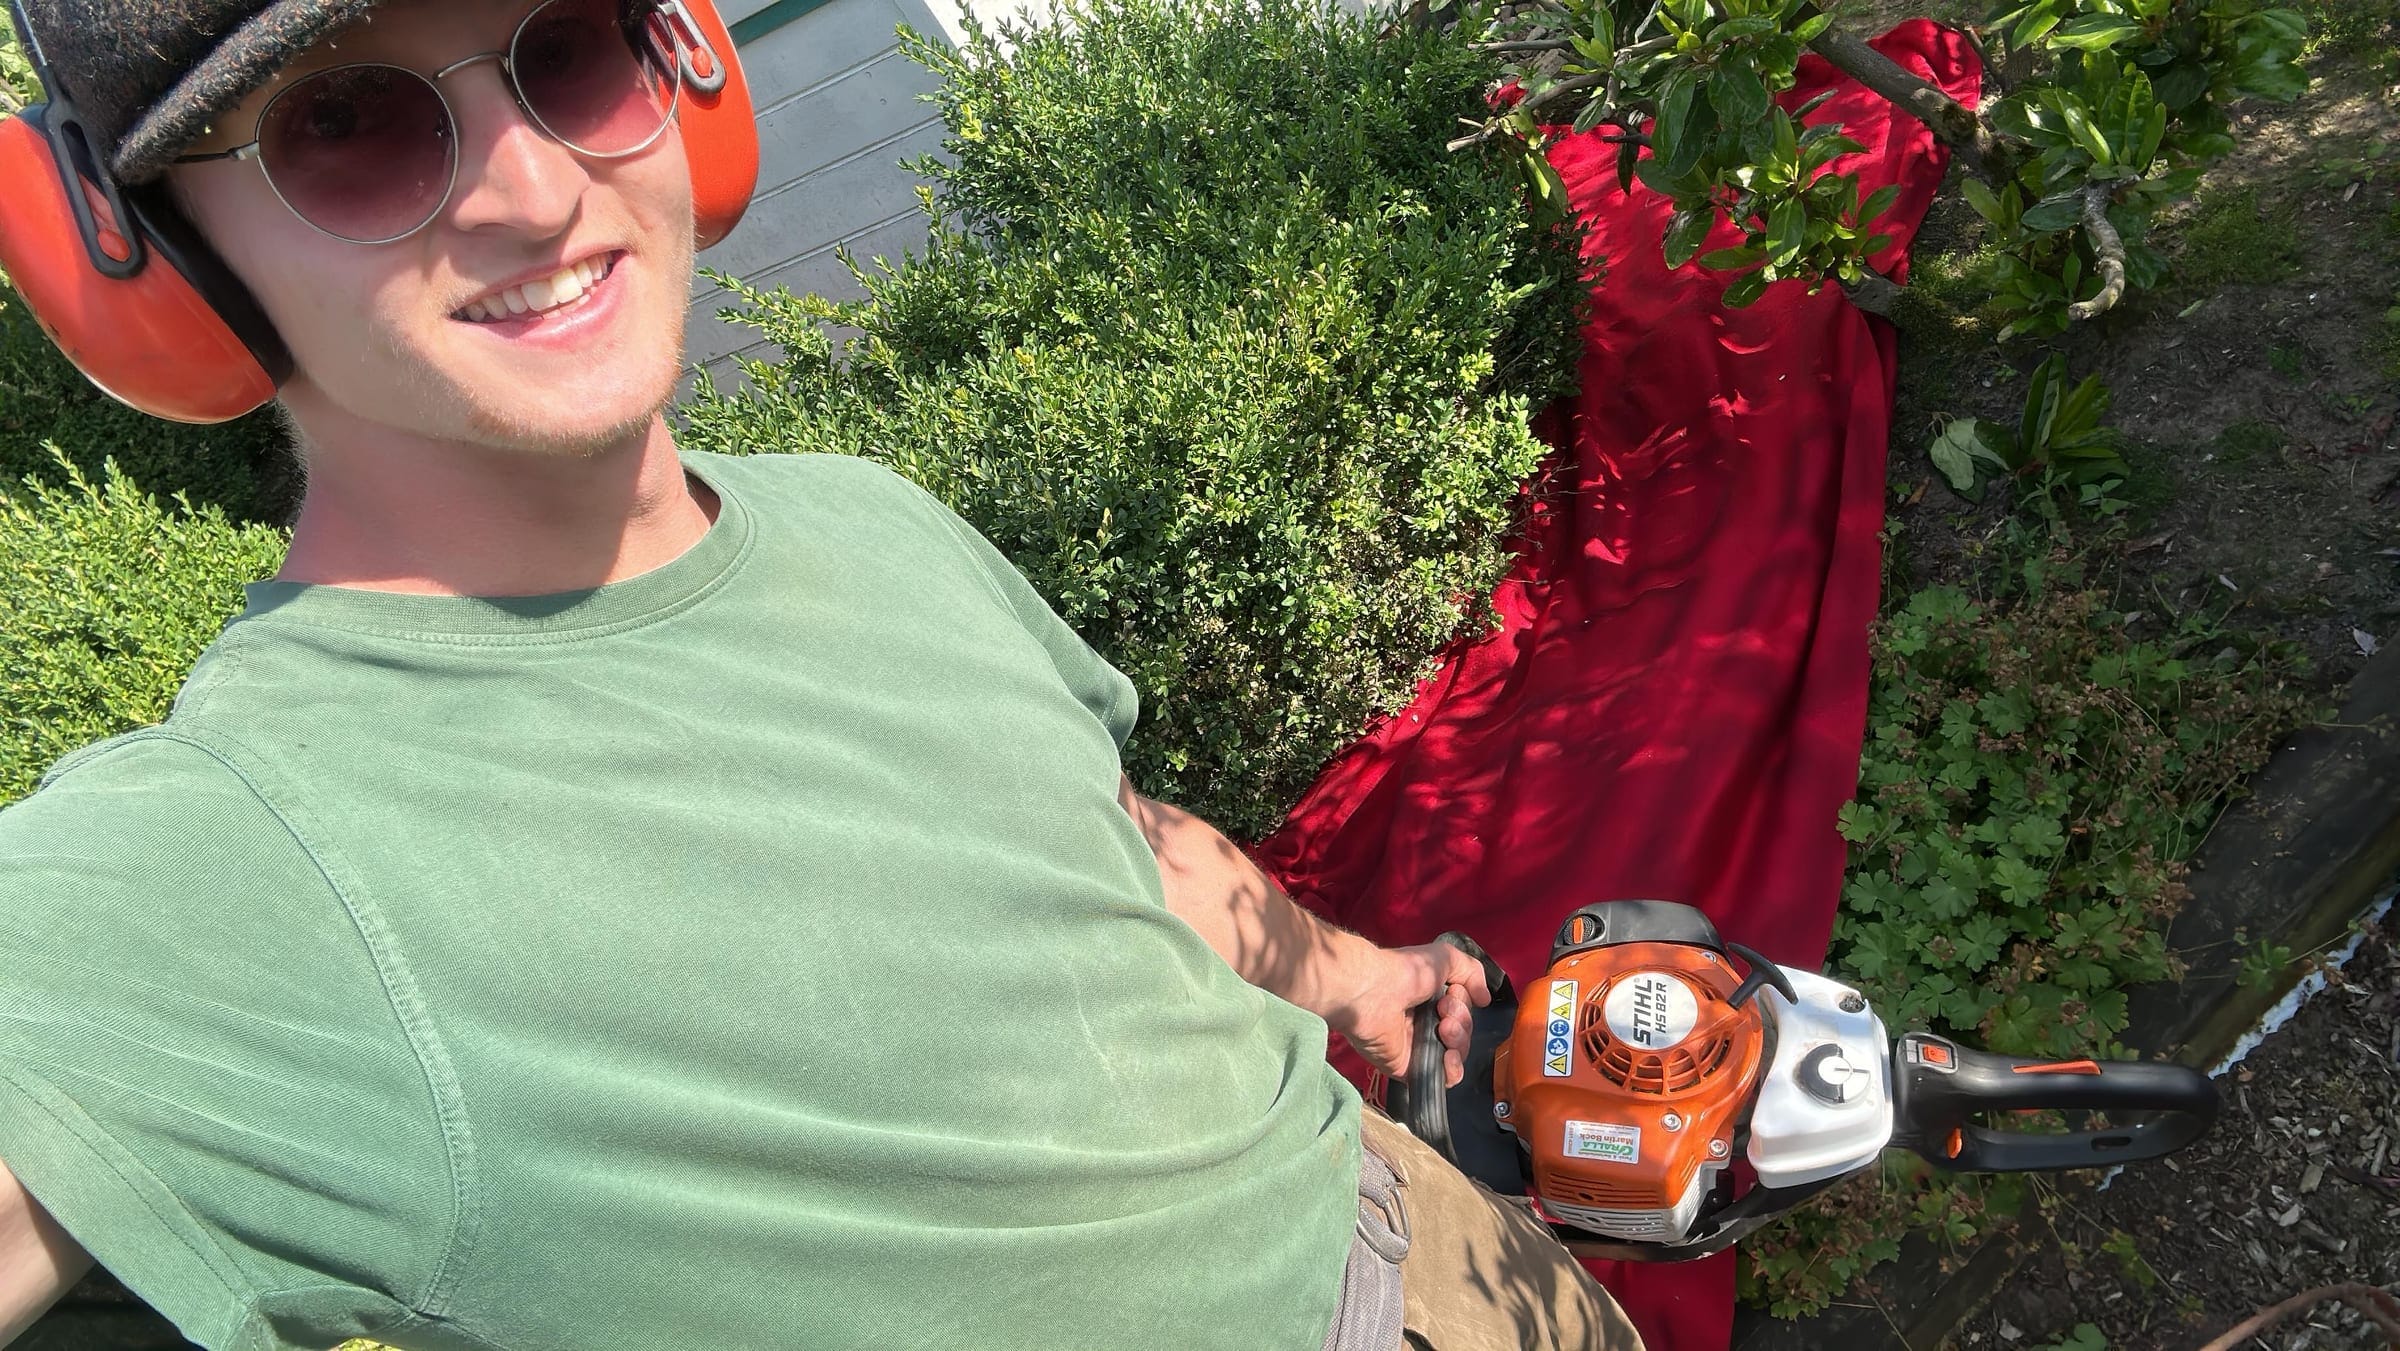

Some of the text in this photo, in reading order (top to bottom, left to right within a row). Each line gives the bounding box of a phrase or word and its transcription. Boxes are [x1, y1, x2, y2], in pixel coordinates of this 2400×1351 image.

[1633, 980, 1652, 1046] STIHL
[1655, 982, 1667, 1034] HS 82 R
[1580, 1133, 1634, 1145] Martin Bock
